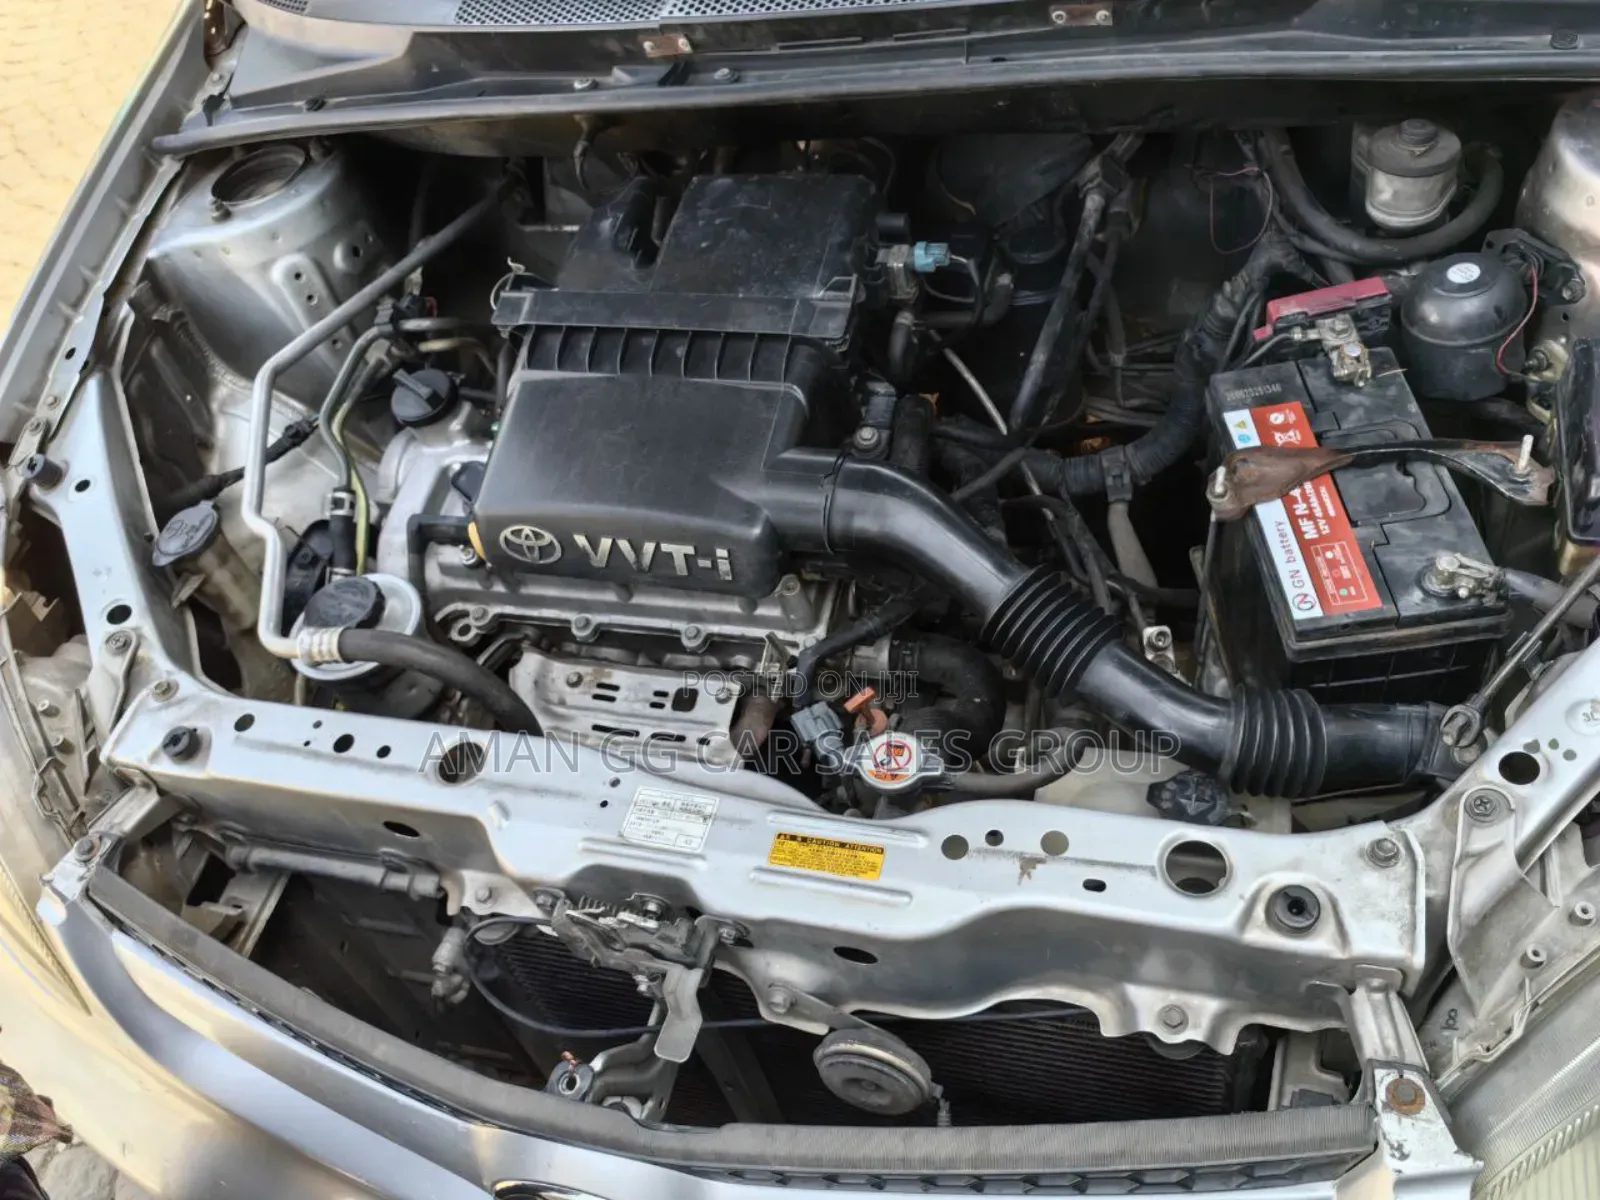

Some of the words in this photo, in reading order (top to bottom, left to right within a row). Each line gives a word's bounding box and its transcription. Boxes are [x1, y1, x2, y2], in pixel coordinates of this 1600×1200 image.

[1274, 521, 1297, 564] battery
[1298, 518, 1320, 539] MF
[573, 533, 732, 581] VVT-i
[1288, 569, 1305, 589] GN
